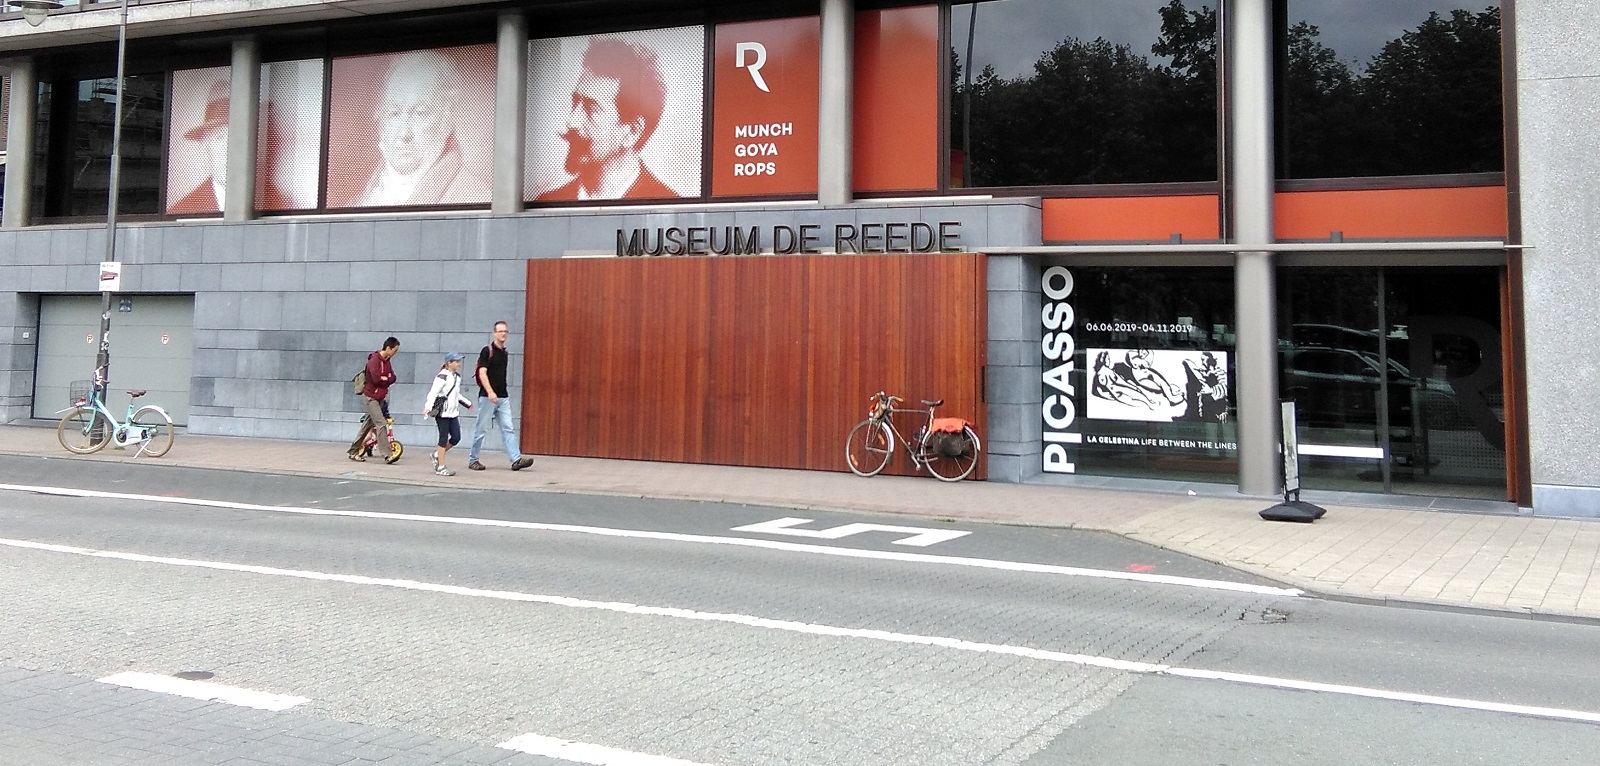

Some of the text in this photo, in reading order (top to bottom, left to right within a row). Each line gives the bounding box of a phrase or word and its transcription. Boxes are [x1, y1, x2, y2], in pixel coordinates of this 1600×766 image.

[735, 123, 793, 138] MUNCH
[735, 142, 779, 157] GOYA
[734, 162, 776, 177] ROPS
[616, 221, 963, 256] MUSEUM DE REEDE
[1042, 265, 1079, 473] PICASSO
[1098, 436, 1139, 445] CELESTINA
[1141, 438, 1157, 446] LIFE
[1159, 439, 1196, 448] BETWEEN
[1197, 441, 1212, 449] THE
[1214, 442, 1237, 450] LINES
